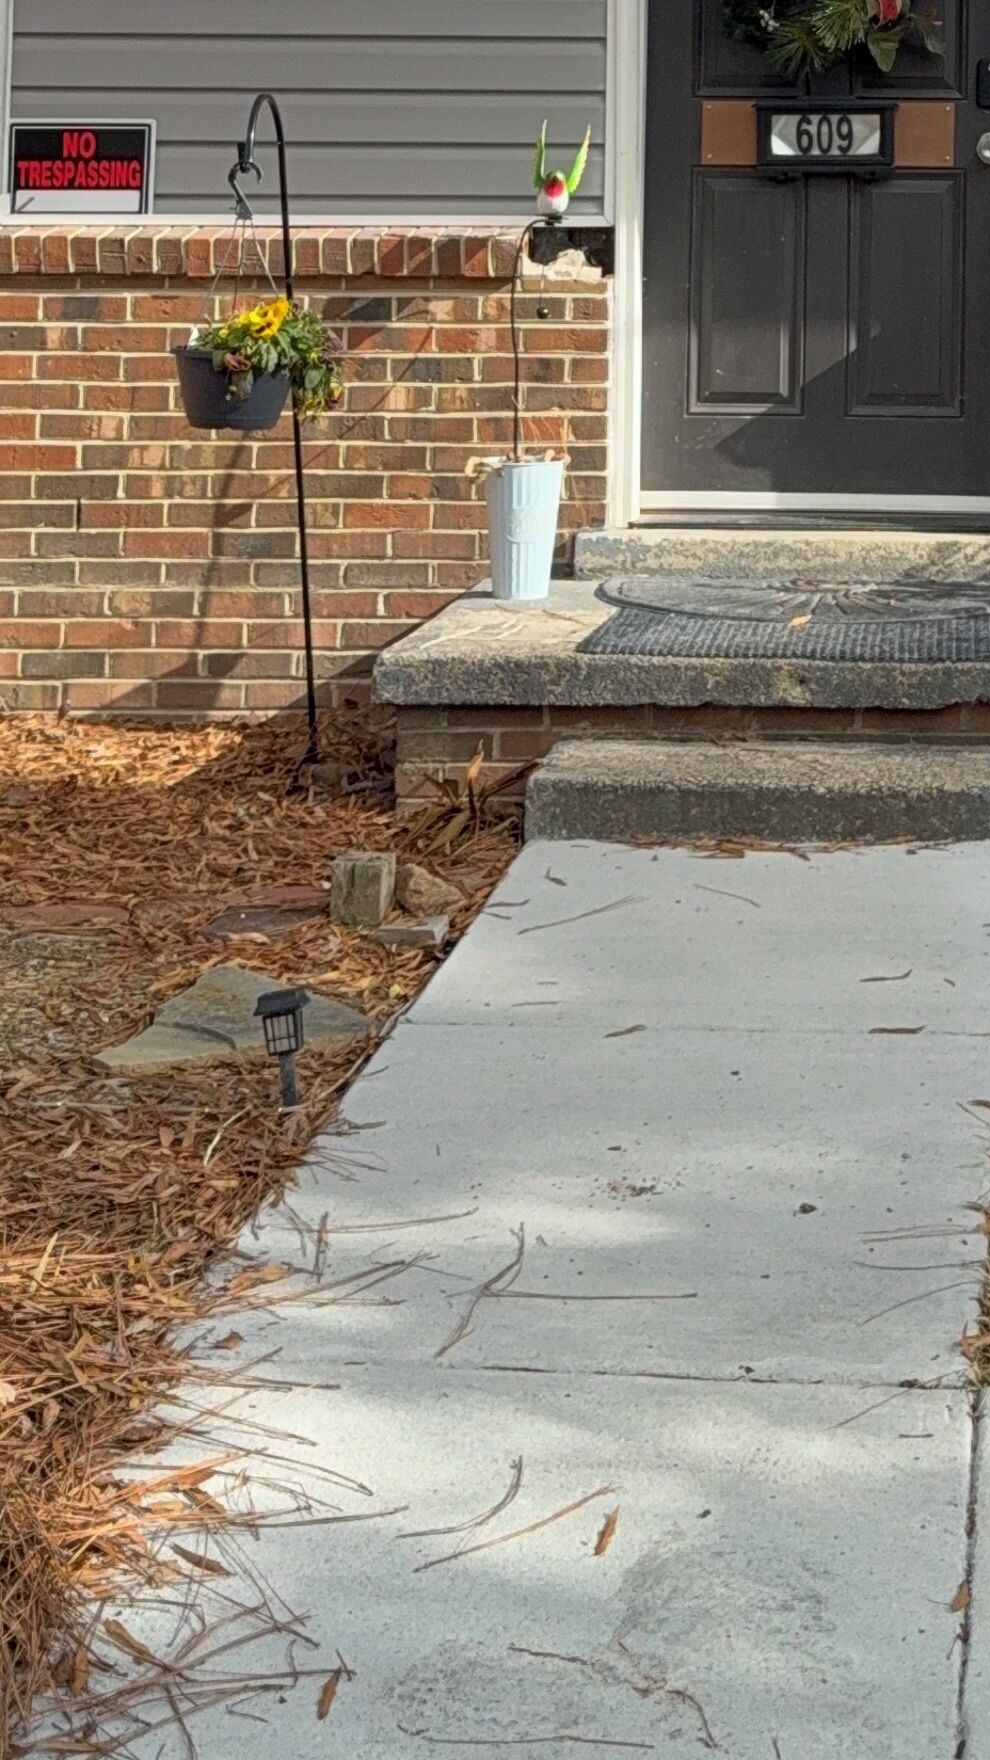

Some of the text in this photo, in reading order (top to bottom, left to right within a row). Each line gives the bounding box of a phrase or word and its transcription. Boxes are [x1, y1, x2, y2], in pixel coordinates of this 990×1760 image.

[62, 132, 96, 158] NO
[796, 115, 853, 154] 609
[17, 160, 141, 187] TRESPASSING
